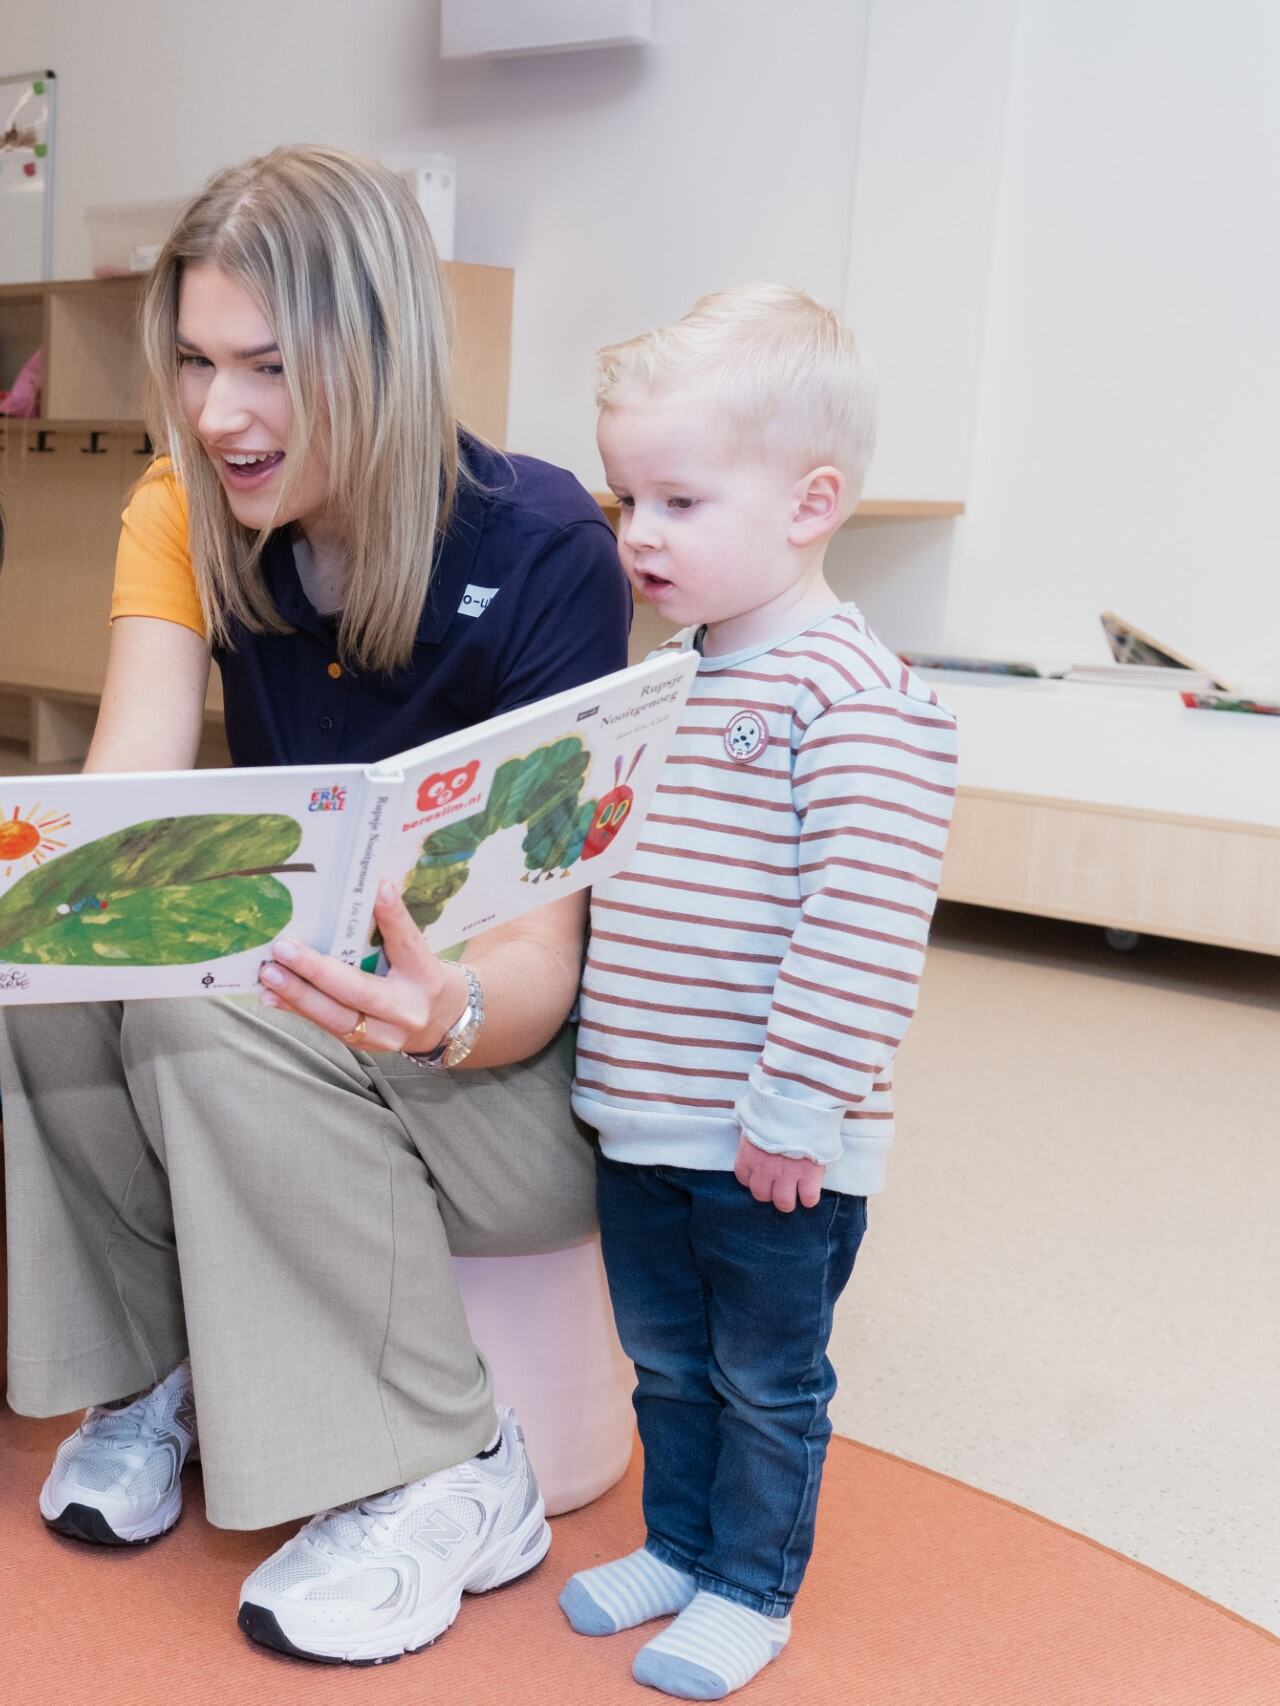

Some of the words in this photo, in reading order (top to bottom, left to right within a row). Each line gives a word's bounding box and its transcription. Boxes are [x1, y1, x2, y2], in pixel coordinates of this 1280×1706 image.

[640, 673, 684, 697] Rupsje
[600, 691, 678, 729] Nooitgenoeg
[308, 801, 346, 812] CARLE
[311, 787, 347, 801] ERIC
[368, 796, 388, 831] Rupsje
[402, 793, 482, 833] bereslim.nl
[353, 832, 379, 894] Nooitgenoeg
[349, 902, 363, 917] Eric
